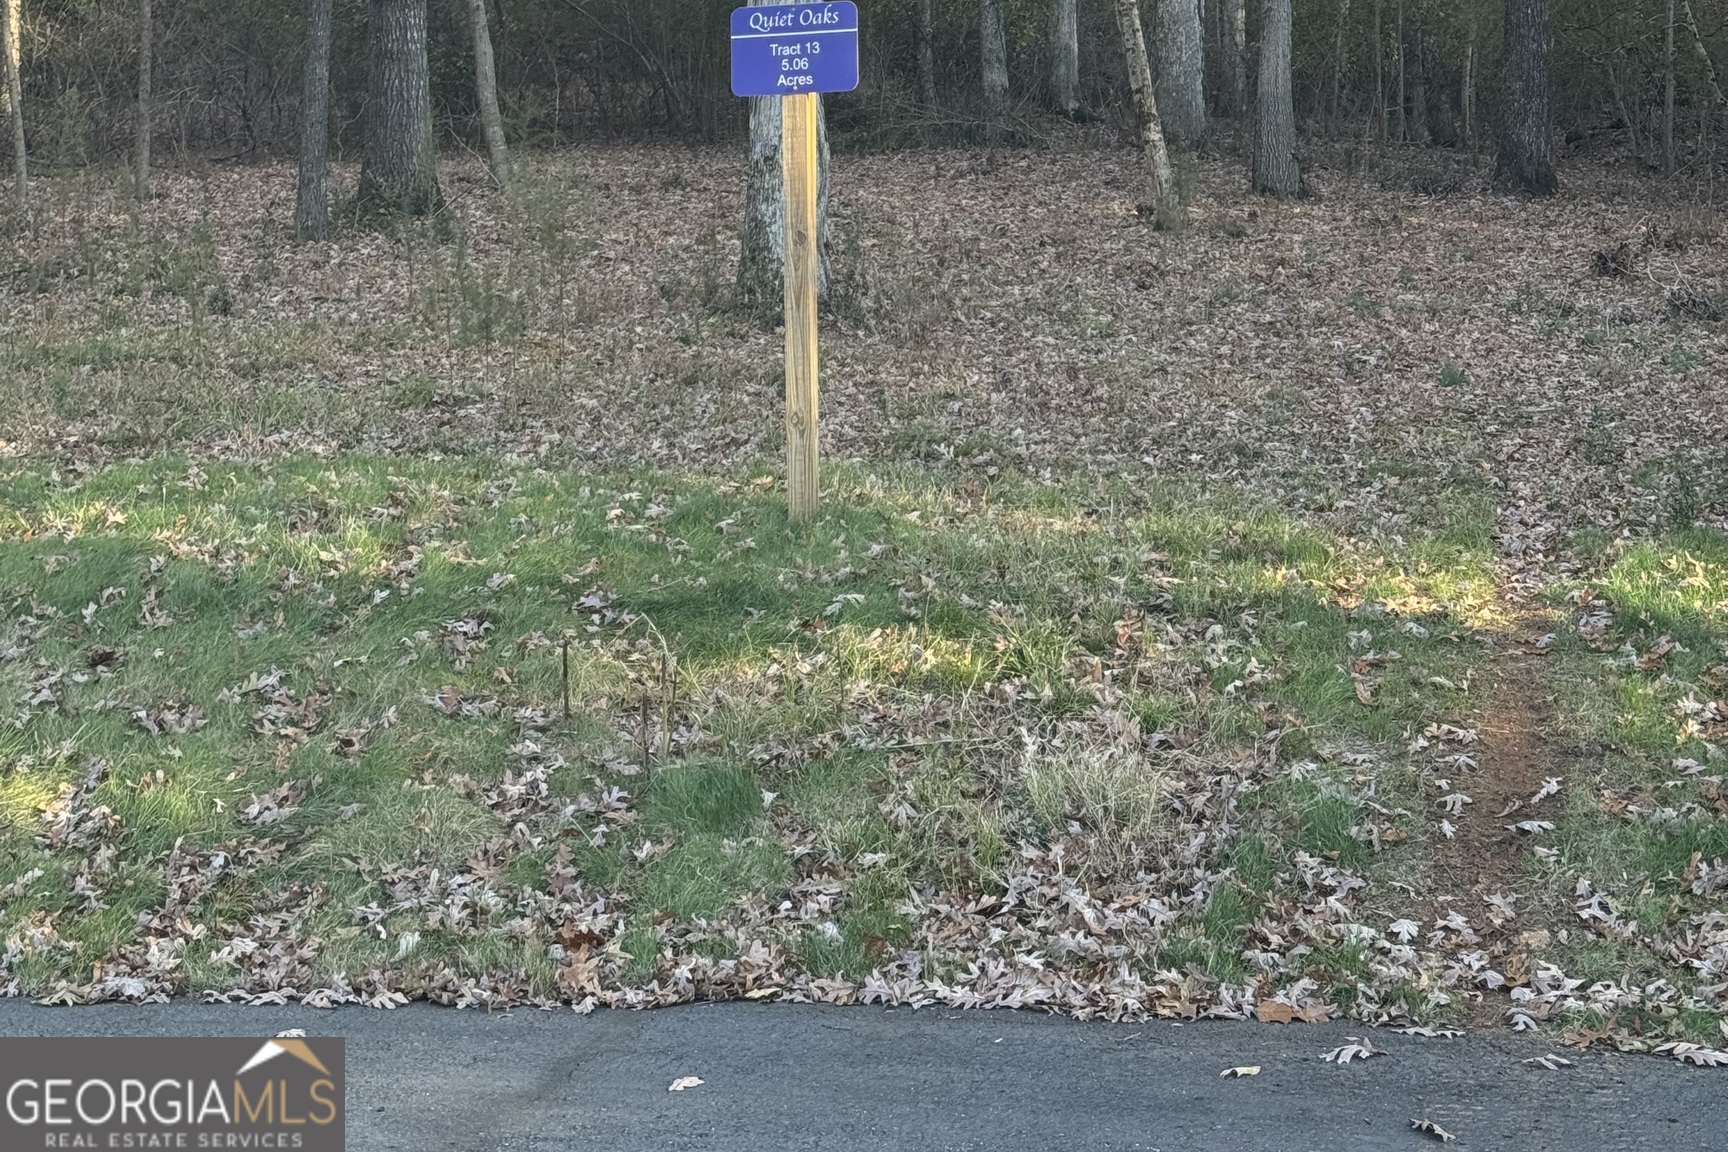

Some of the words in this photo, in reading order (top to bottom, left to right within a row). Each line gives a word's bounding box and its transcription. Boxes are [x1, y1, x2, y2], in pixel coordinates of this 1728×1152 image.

[749, 11, 795, 33] Quiet
[799, 3, 840, 26] Oaks
[769, 42, 801, 57] Tract
[805, 41, 820, 54] 13
[781, 57, 809, 71] 5.06
[777, 74, 814, 87] Acres
